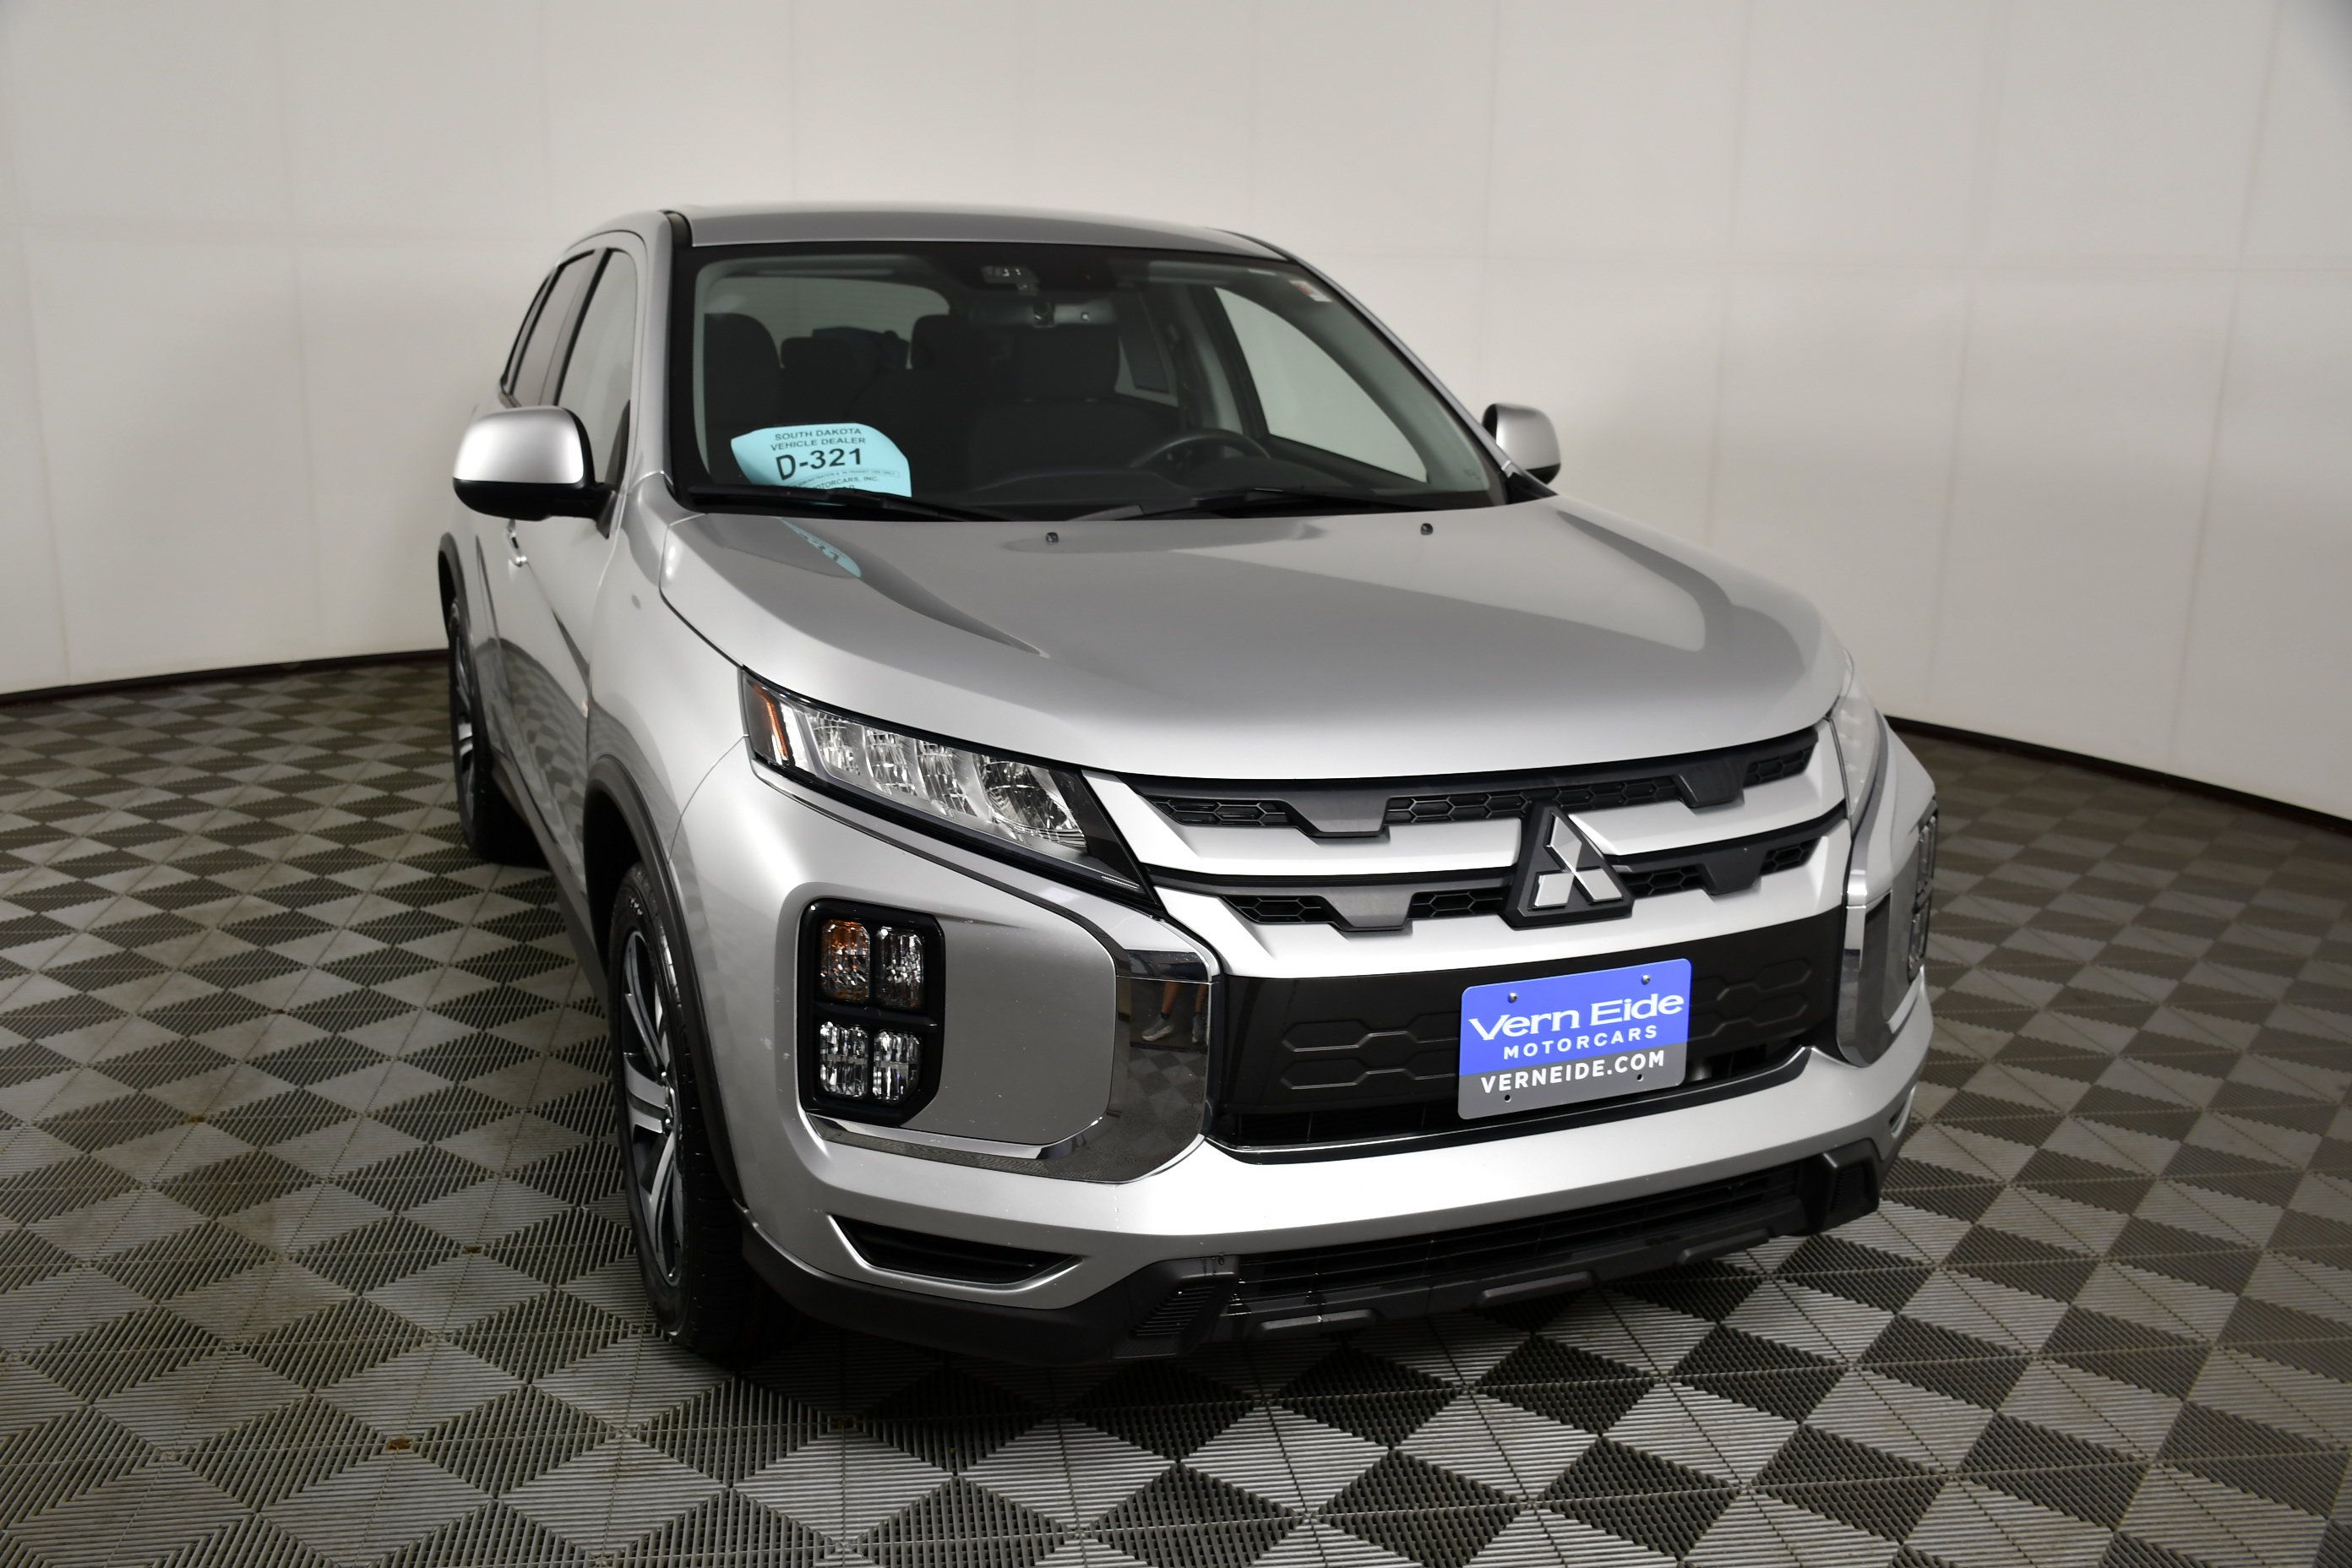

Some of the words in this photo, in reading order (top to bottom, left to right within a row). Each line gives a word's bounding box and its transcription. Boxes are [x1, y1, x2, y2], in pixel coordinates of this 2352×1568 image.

[770, 441, 817, 451] VEHICLE
[775, 432, 813, 441] SOUTH
[816, 428, 861, 437] DAKOTA
[776, 448, 861, 481] D-321
[1468, 1009, 1581, 1041] Vern
[1589, 993, 1685, 1026] Eide
[1503, 1025, 1658, 1060] MOTORCARS
[1480, 1050, 1665, 1093] VERNEIDE.COM
